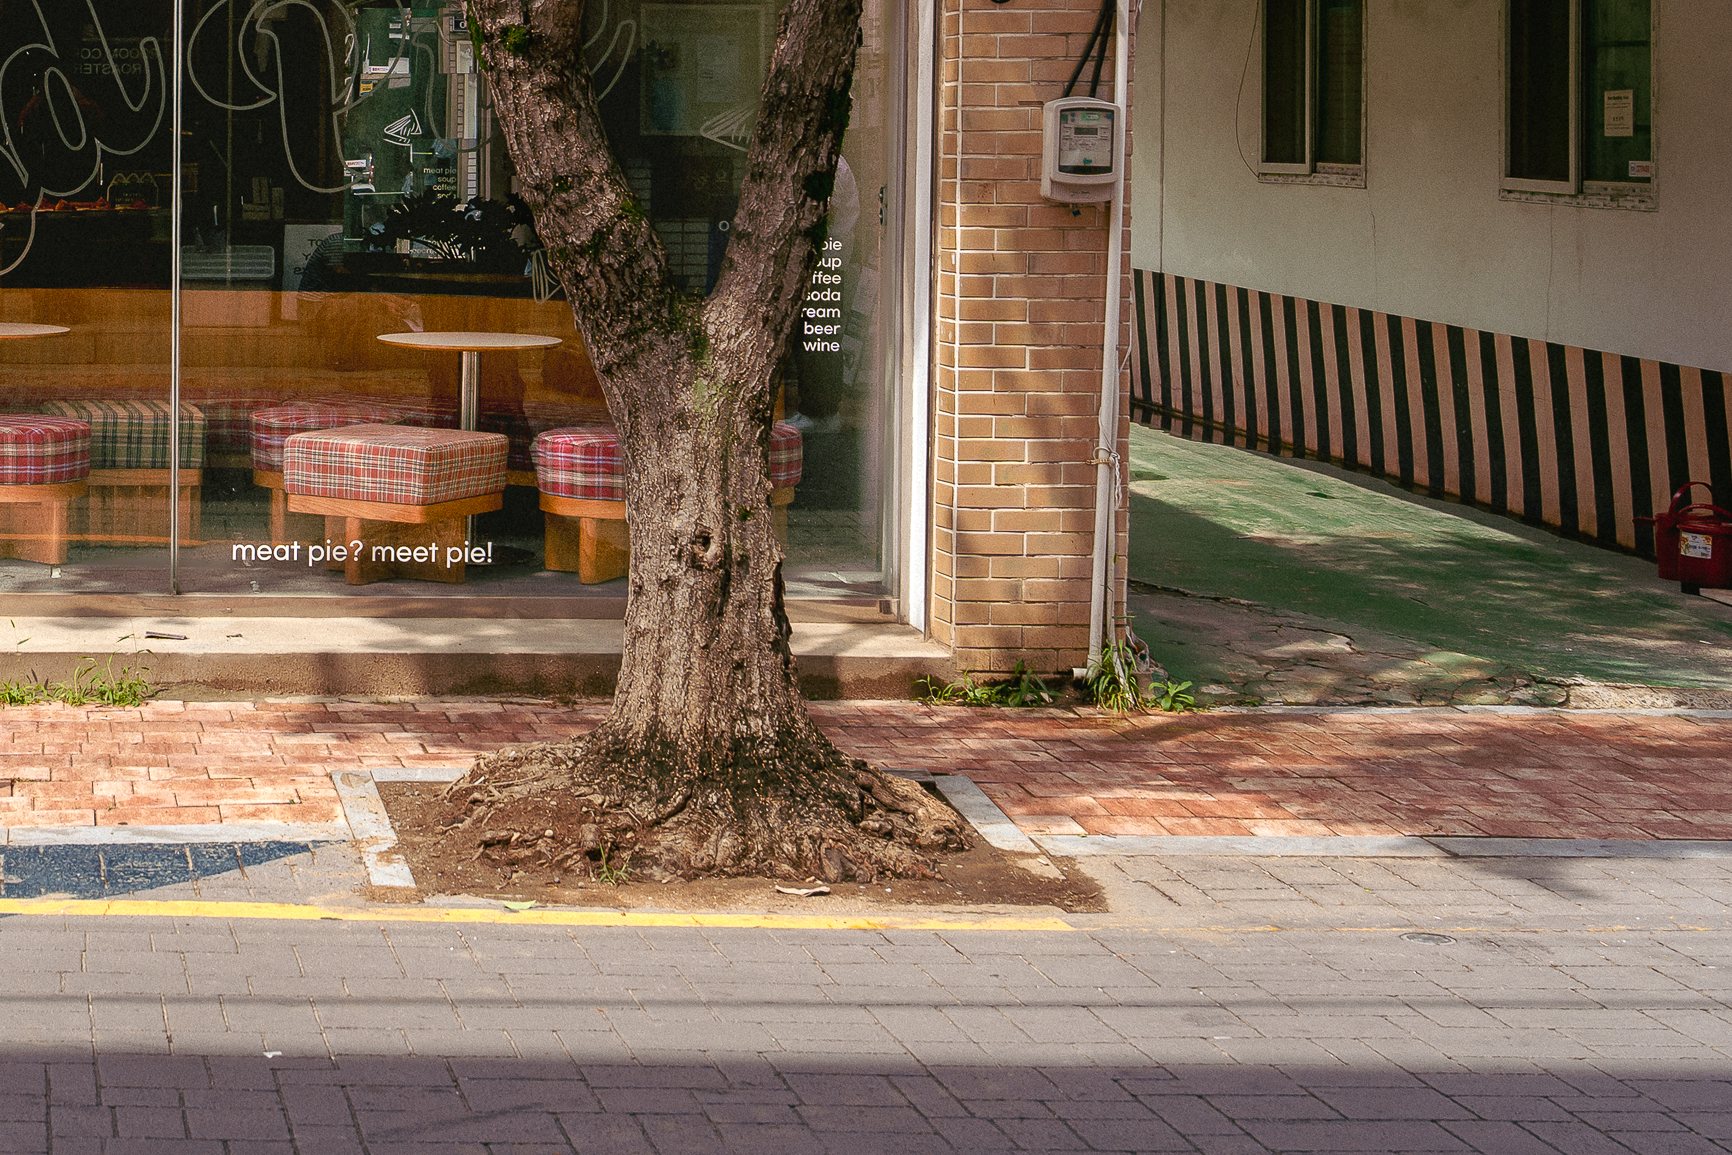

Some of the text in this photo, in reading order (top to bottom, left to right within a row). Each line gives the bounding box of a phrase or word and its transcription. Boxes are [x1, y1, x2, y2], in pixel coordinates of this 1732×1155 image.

[804, 321, 842, 335] beer
[802, 338, 841, 352] wine
[232, 539, 494, 568] meat pie? meet pie!
